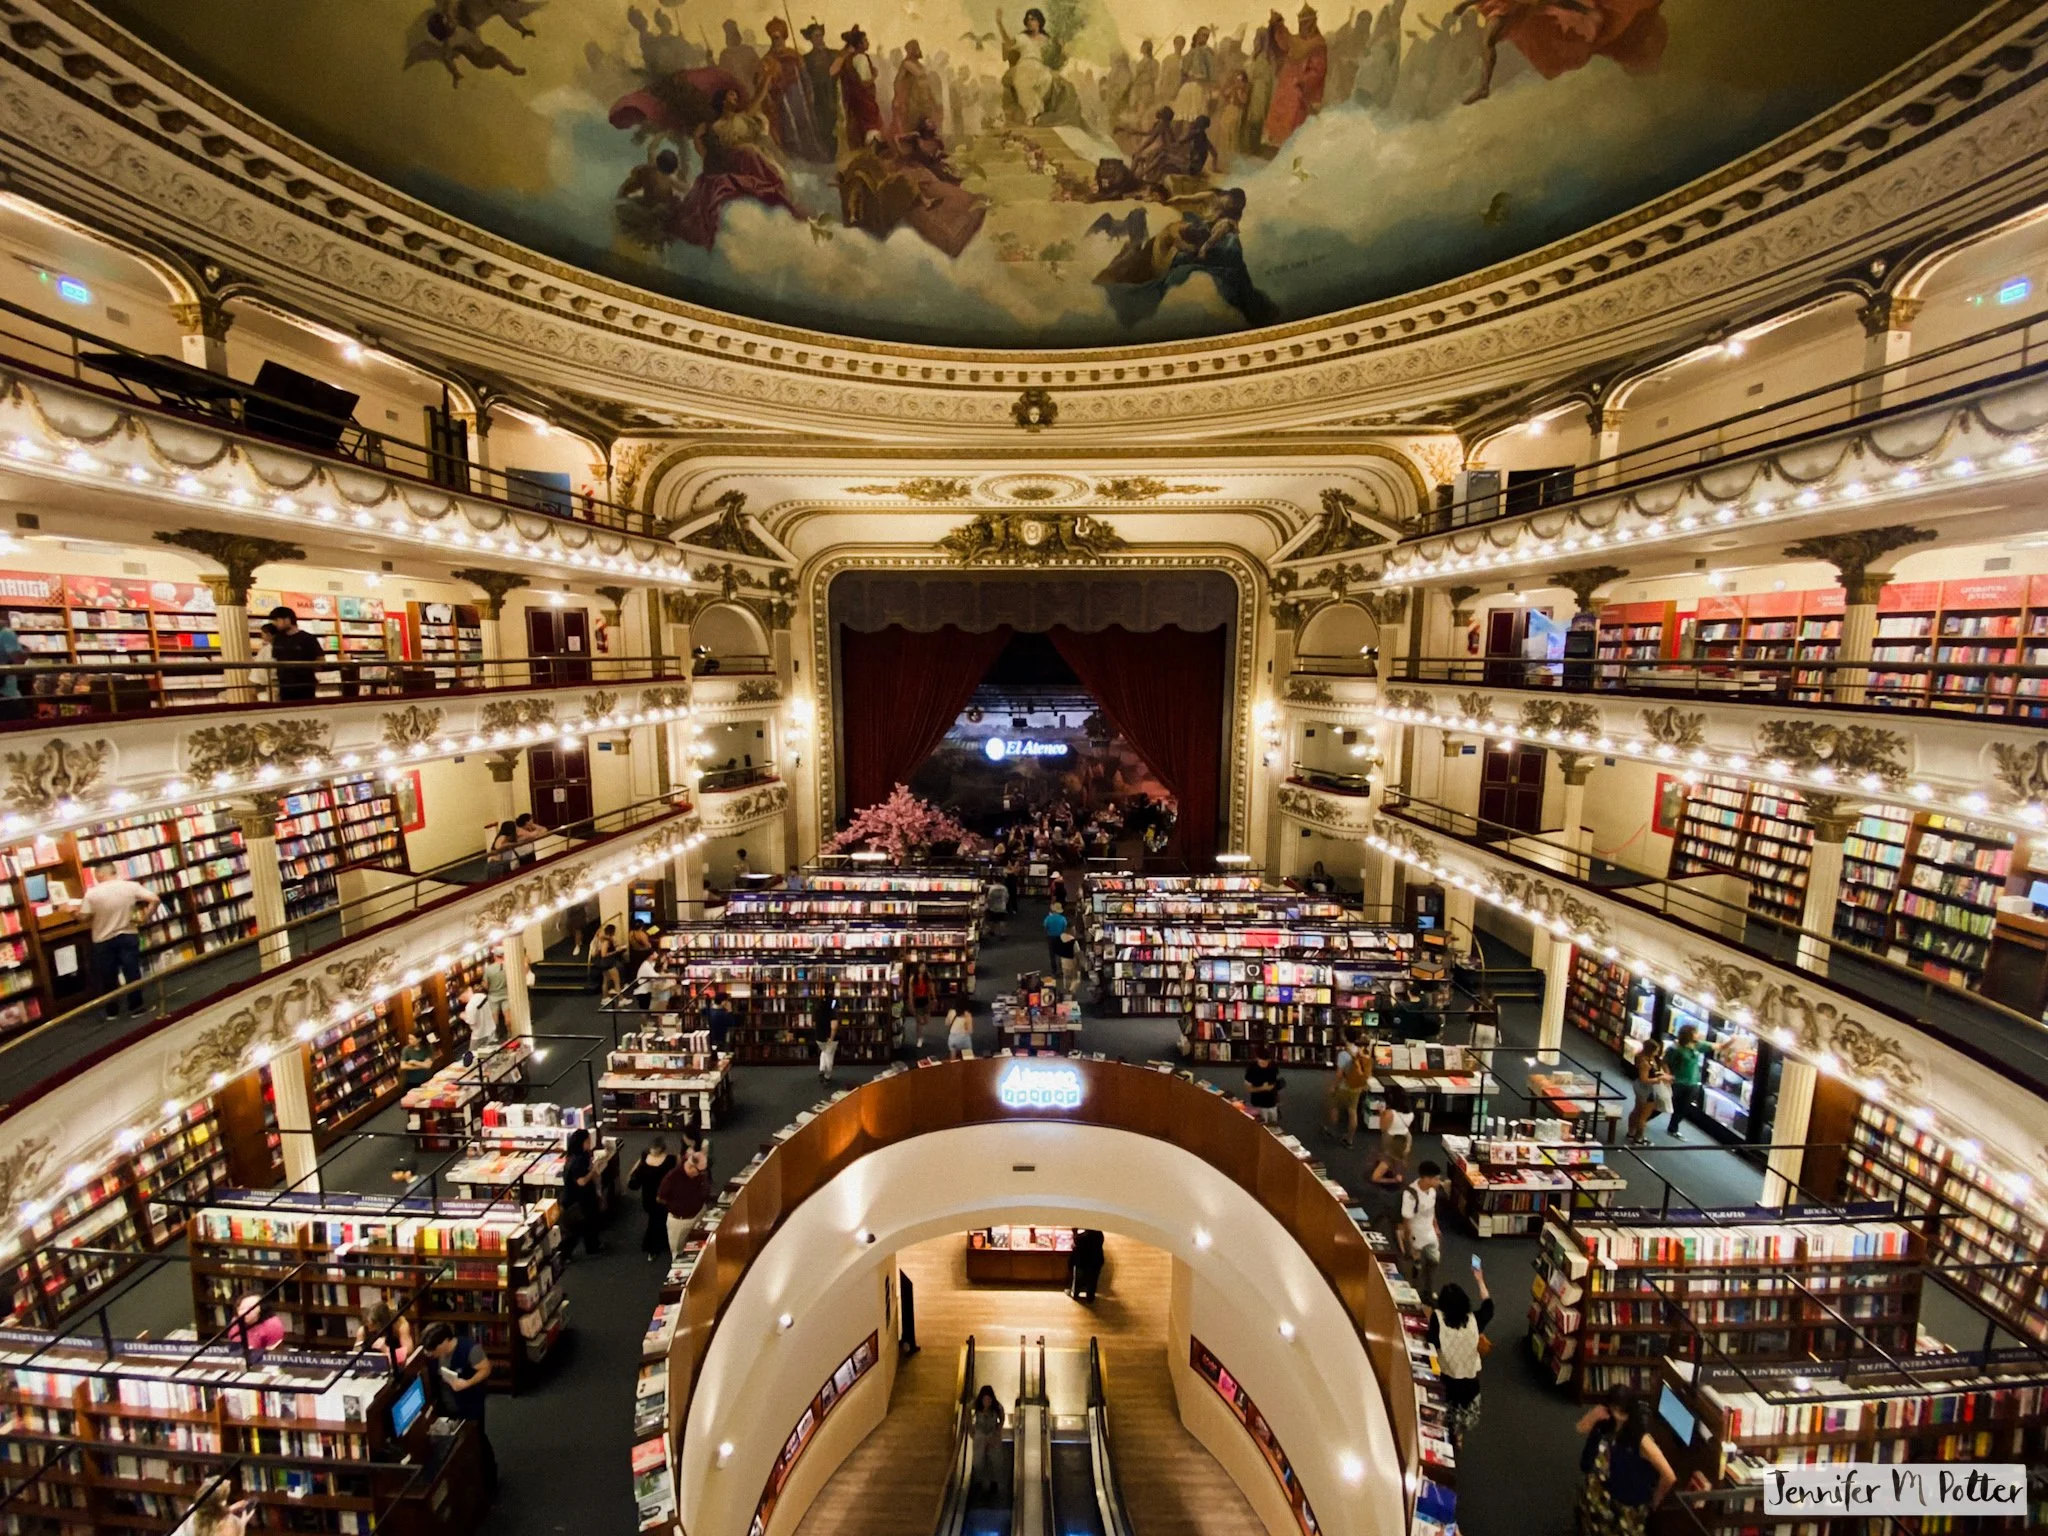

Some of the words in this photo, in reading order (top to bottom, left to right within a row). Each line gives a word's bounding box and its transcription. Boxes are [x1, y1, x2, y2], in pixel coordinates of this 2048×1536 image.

[1005, 740, 1022, 755] El
[1022, 740, 1068, 755] Ateneo
[1803, 1207, 1847, 1215] BIOGRAIAS
[0, 1331, 44, 1343] ITERATURA
[124, 1343, 177, 1352] LITERATURA
[178, 1344, 229, 1353] ARGETINA
[262, 1354, 318, 1364] LITERATURA
[319, 1357, 373, 1367] ARGENINA
[1712, 1368, 1756, 1377] POLITCA
